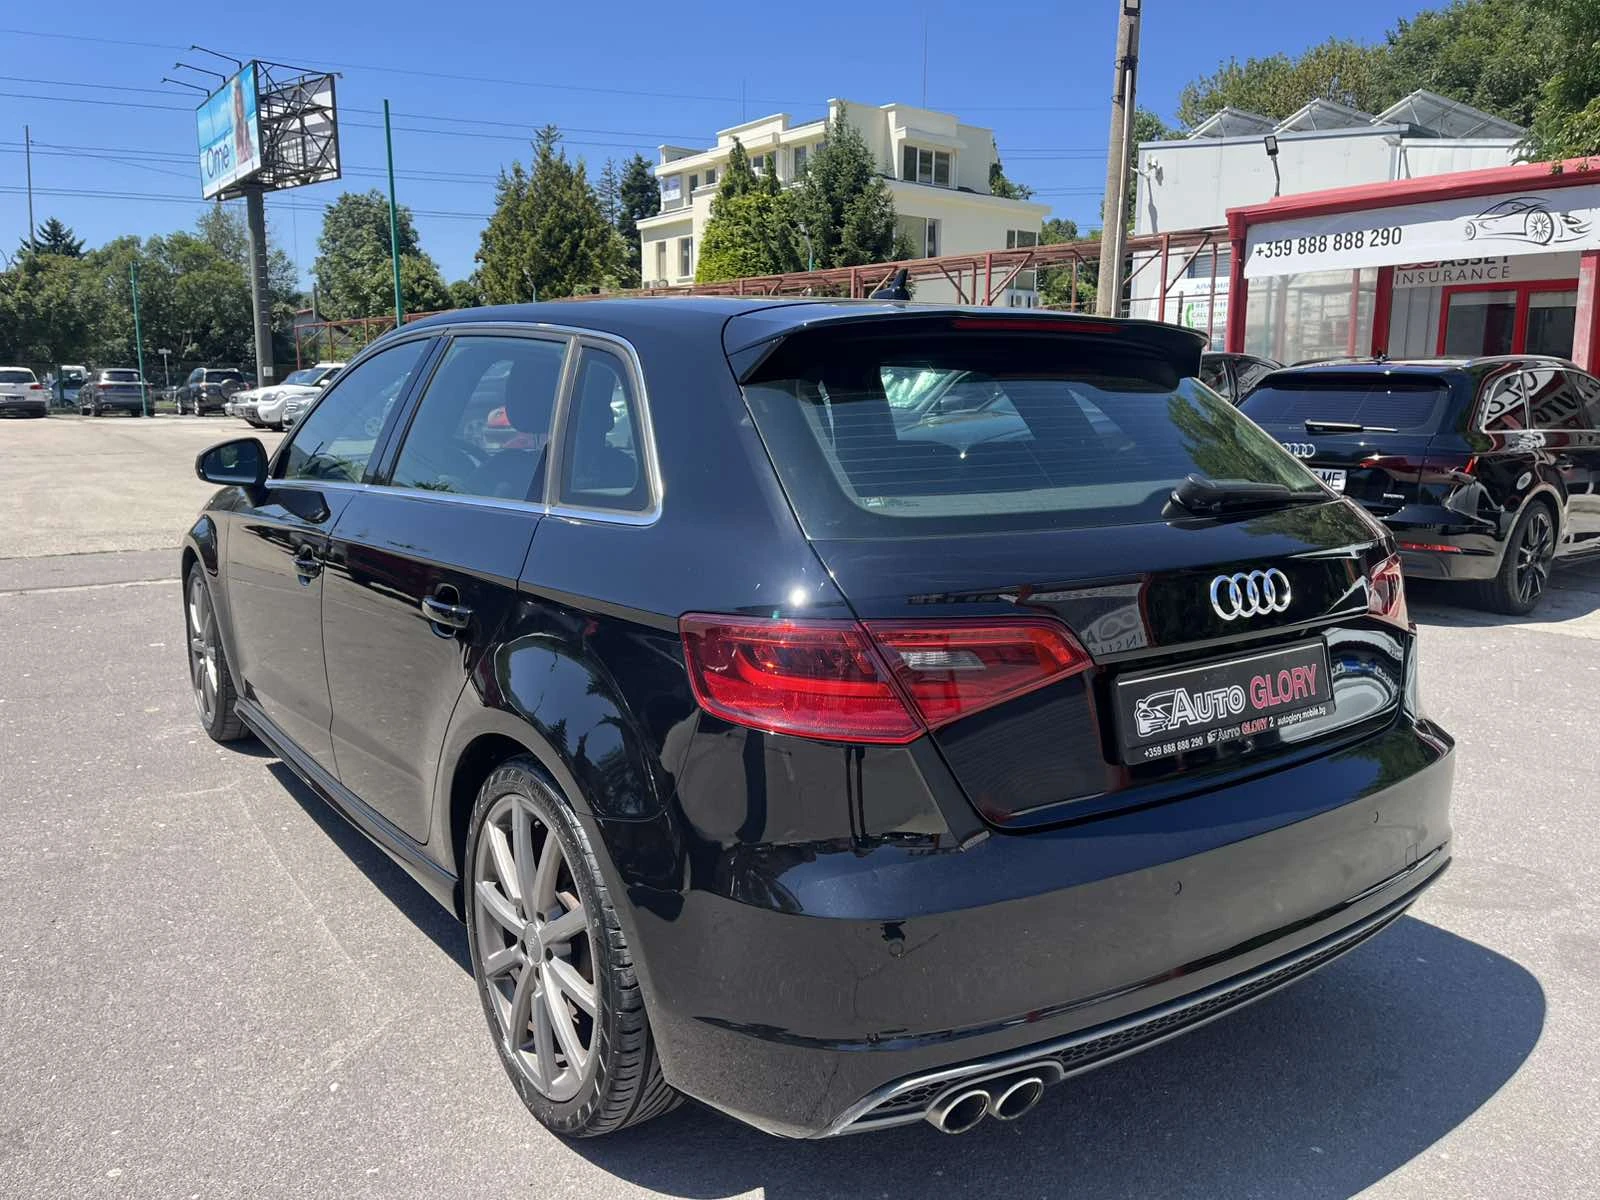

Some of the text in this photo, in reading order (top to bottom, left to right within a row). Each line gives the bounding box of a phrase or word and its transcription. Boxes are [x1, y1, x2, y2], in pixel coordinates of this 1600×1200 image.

[1255, 227, 1402, 259] +359 888 888 290
[1394, 265, 1512, 285] INSURANCE
[1250, 664, 1316, 709] GLORY
[1144, 745, 1162, 758] +359
[1163, 742, 1176, 754] 888
[1177, 739, 1190, 751] 888
[1191, 736, 1204, 748] 290
[1241, 717, 1268, 735] GLORY
[1269, 716, 1274, 728] 2
[1277, 706, 1326, 725] autoglory.mobile.bg
